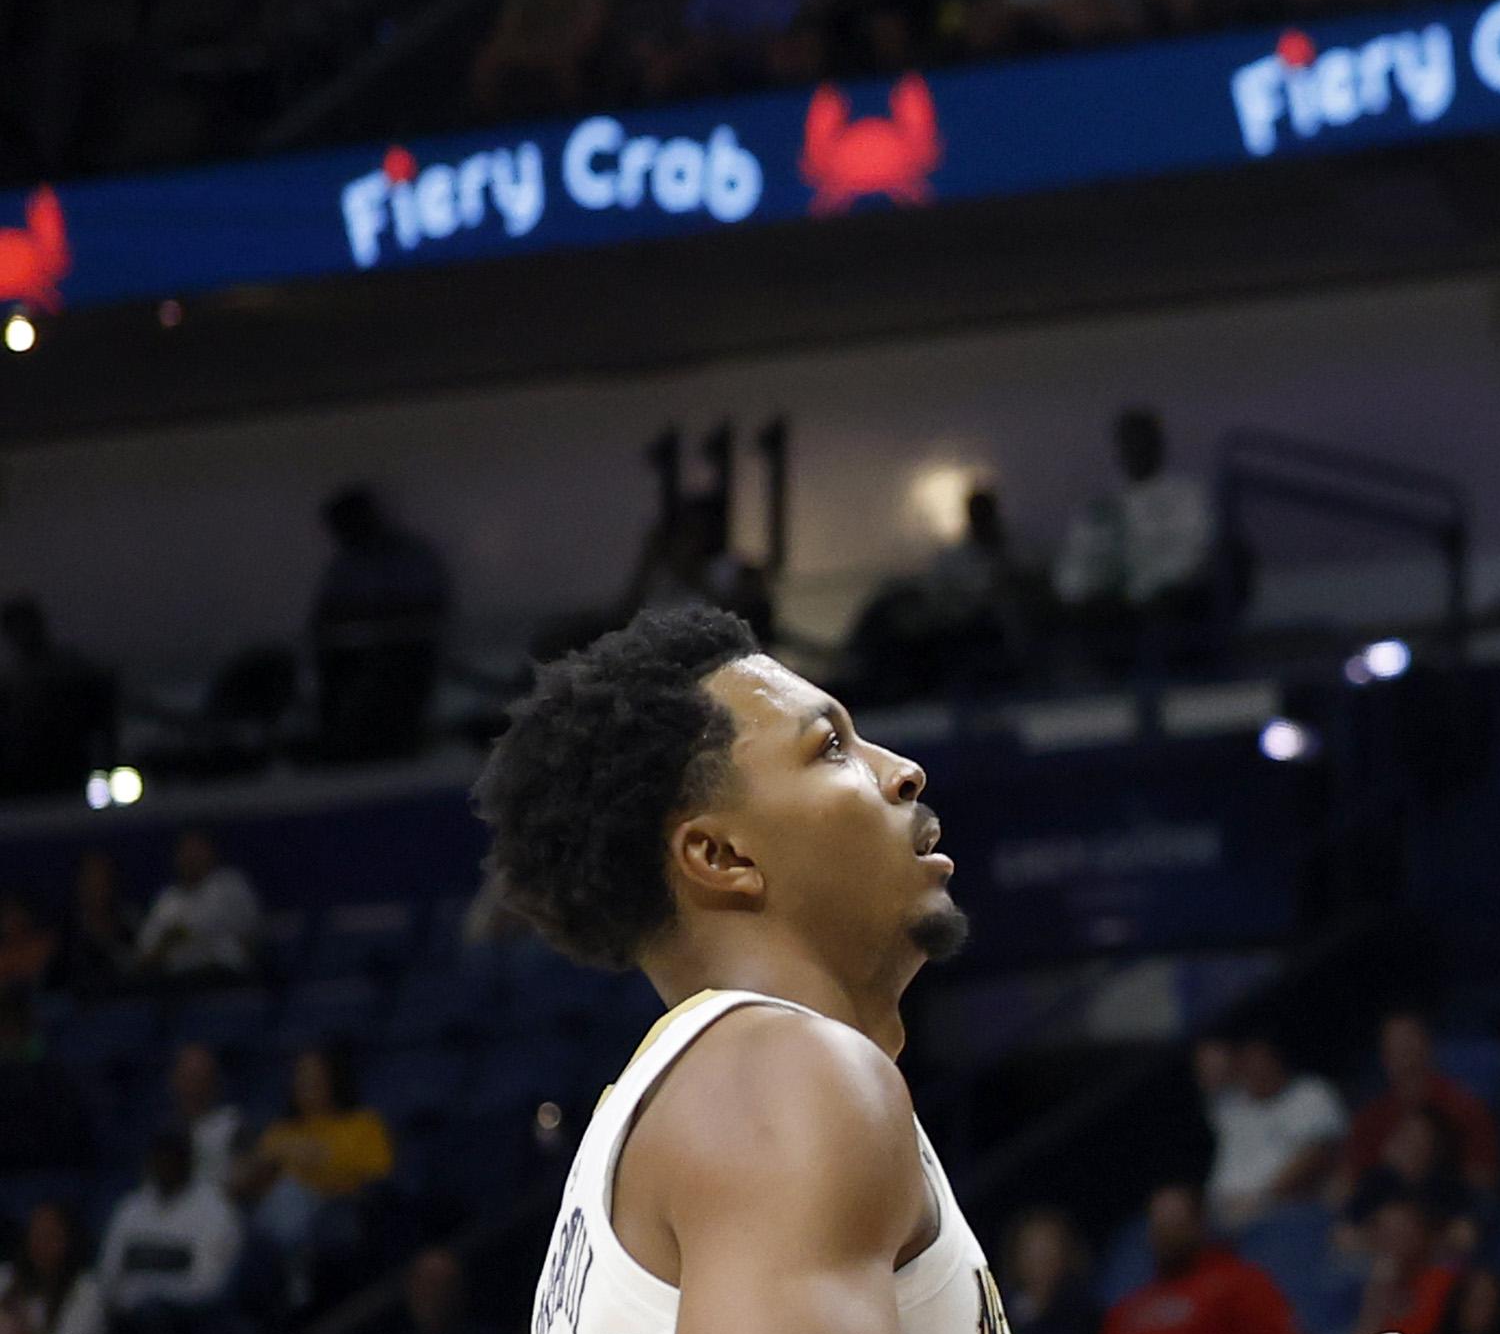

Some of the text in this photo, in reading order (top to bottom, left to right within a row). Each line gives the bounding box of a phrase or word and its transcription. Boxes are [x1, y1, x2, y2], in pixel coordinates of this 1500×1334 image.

[1231, 28, 1455, 157] Fiery
[341, 116, 763, 268] Fiery Crab
